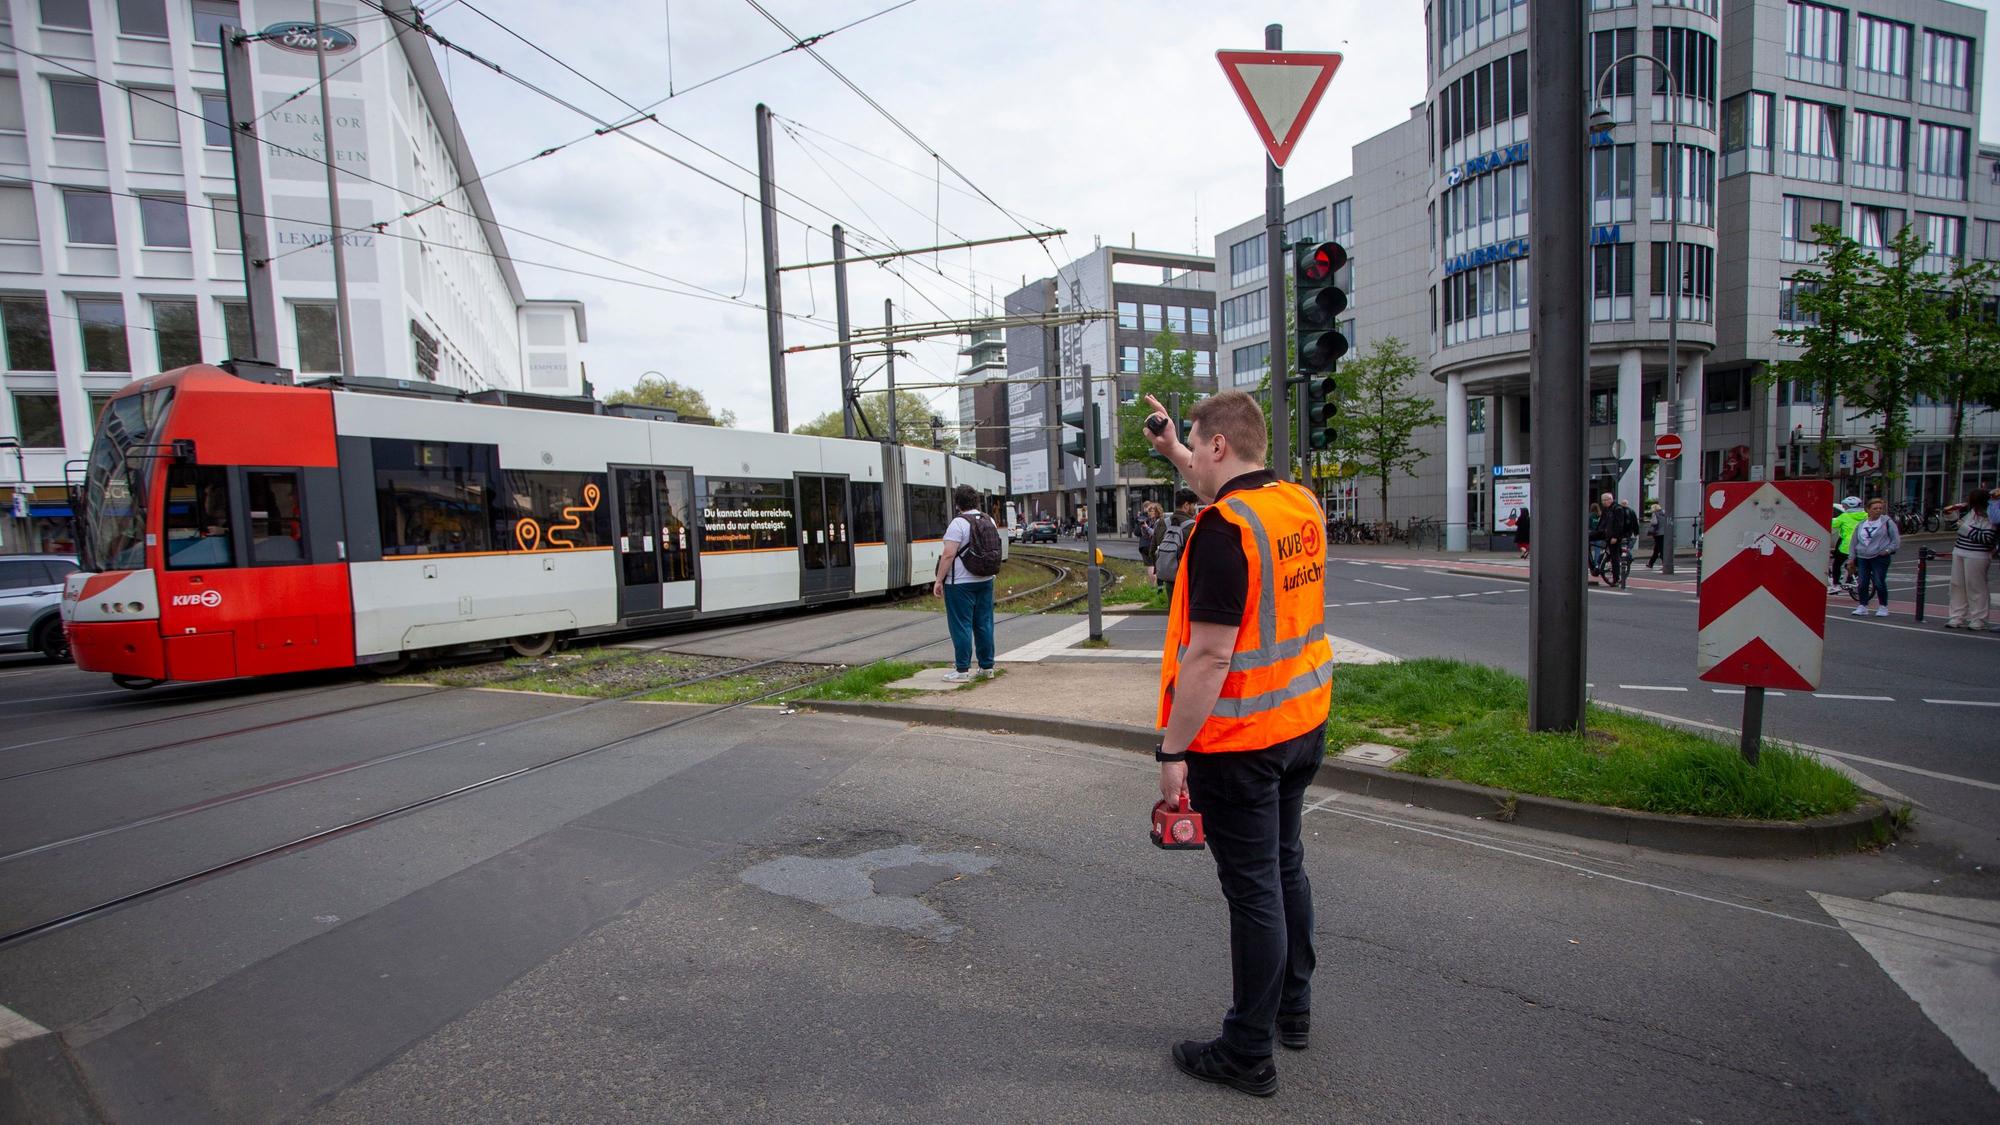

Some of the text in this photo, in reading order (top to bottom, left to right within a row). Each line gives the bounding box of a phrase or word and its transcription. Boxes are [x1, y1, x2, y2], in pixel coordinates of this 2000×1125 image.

[283, 28, 336, 50] Ford
[269, 111, 361, 129] VENAOR
[269, 146, 367, 162] HANSEIN
[278, 232, 376, 248] LEMPRTZ
[1504, 466, 1529, 474] Neumark
[704, 508, 793, 519] Du kannst alles erreichen,
[705, 521, 786, 531] wenn du nur einsteigst.
[1277, 532, 1303, 560] KVB
[1283, 562, 1323, 592] Aufsich
[172, 594, 201, 606] KVB
